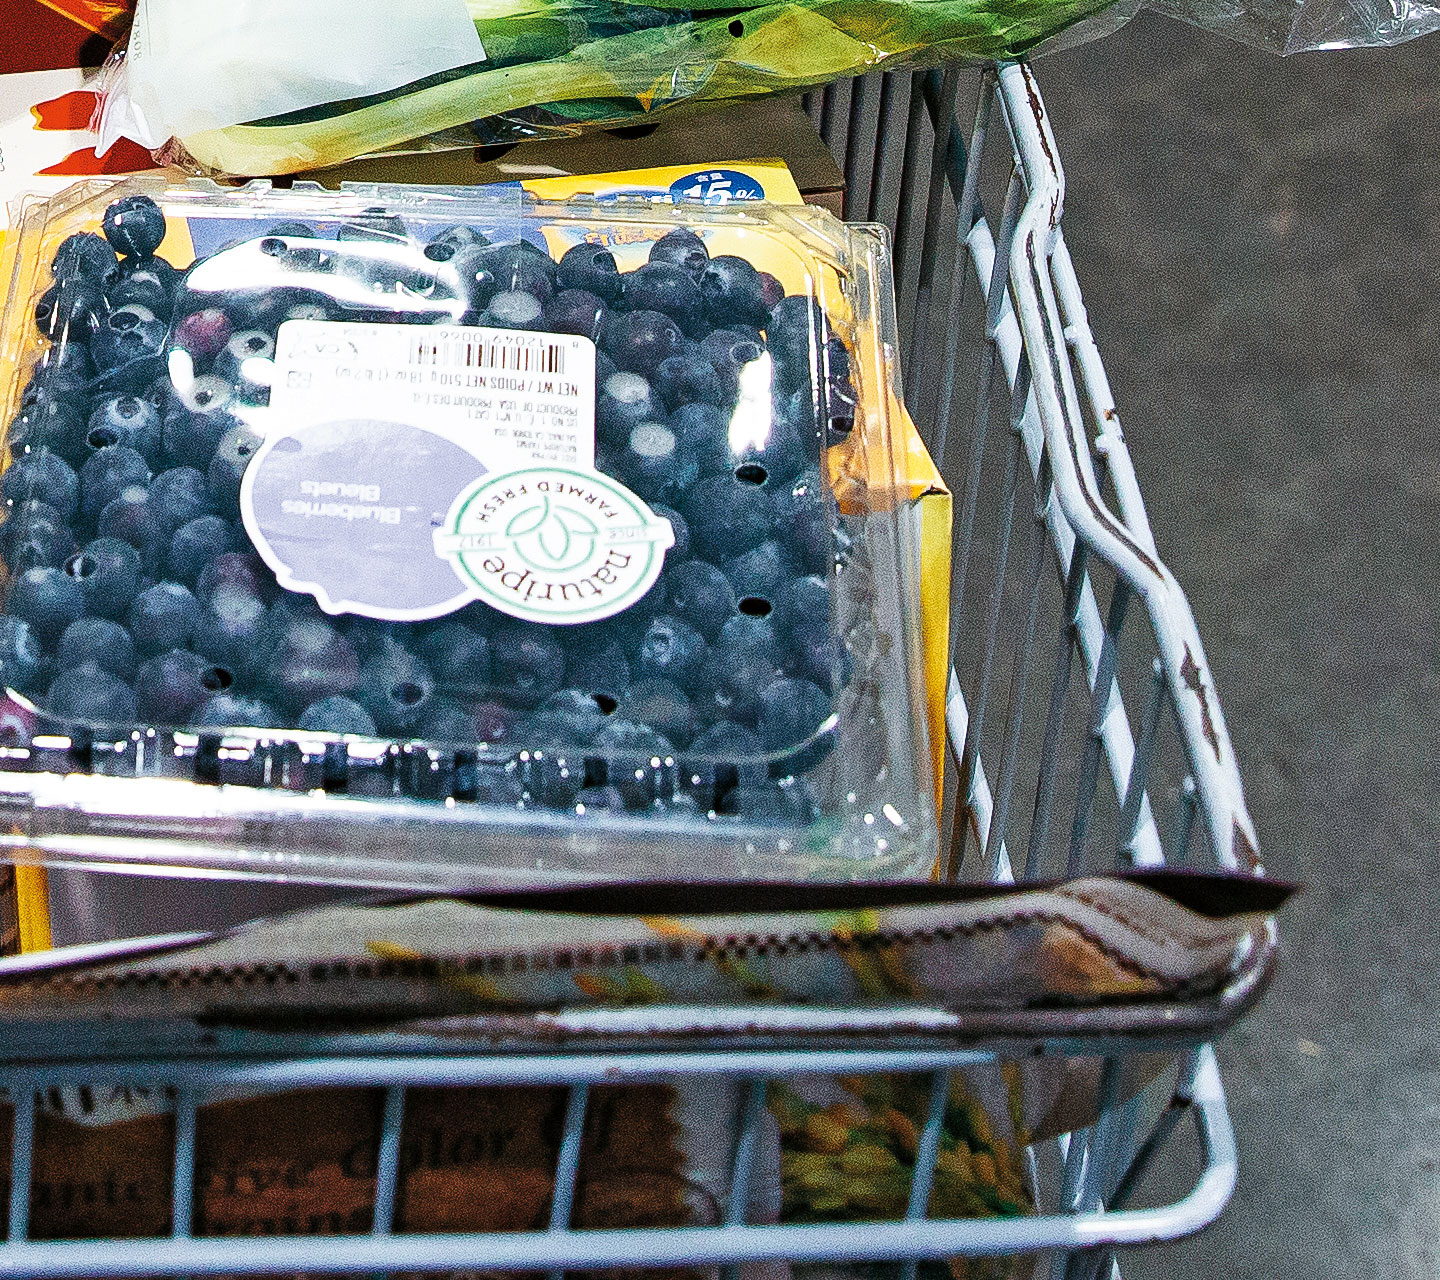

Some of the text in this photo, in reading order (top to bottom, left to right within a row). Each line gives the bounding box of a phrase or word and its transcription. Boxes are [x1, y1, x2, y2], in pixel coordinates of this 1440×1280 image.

[440, 373, 461, 388] 510
[464, 375, 487, 389] NET
[490, 376, 525, 392] POIDS
[538, 381, 555, 395] WT
[558, 382, 579, 397] NET
[300, 480, 381, 502] Bleuets
[475, 481, 618, 523] FARMED FRESH
[281, 499, 401, 525] Blueberries
[483, 549, 631, 602] naturipe
